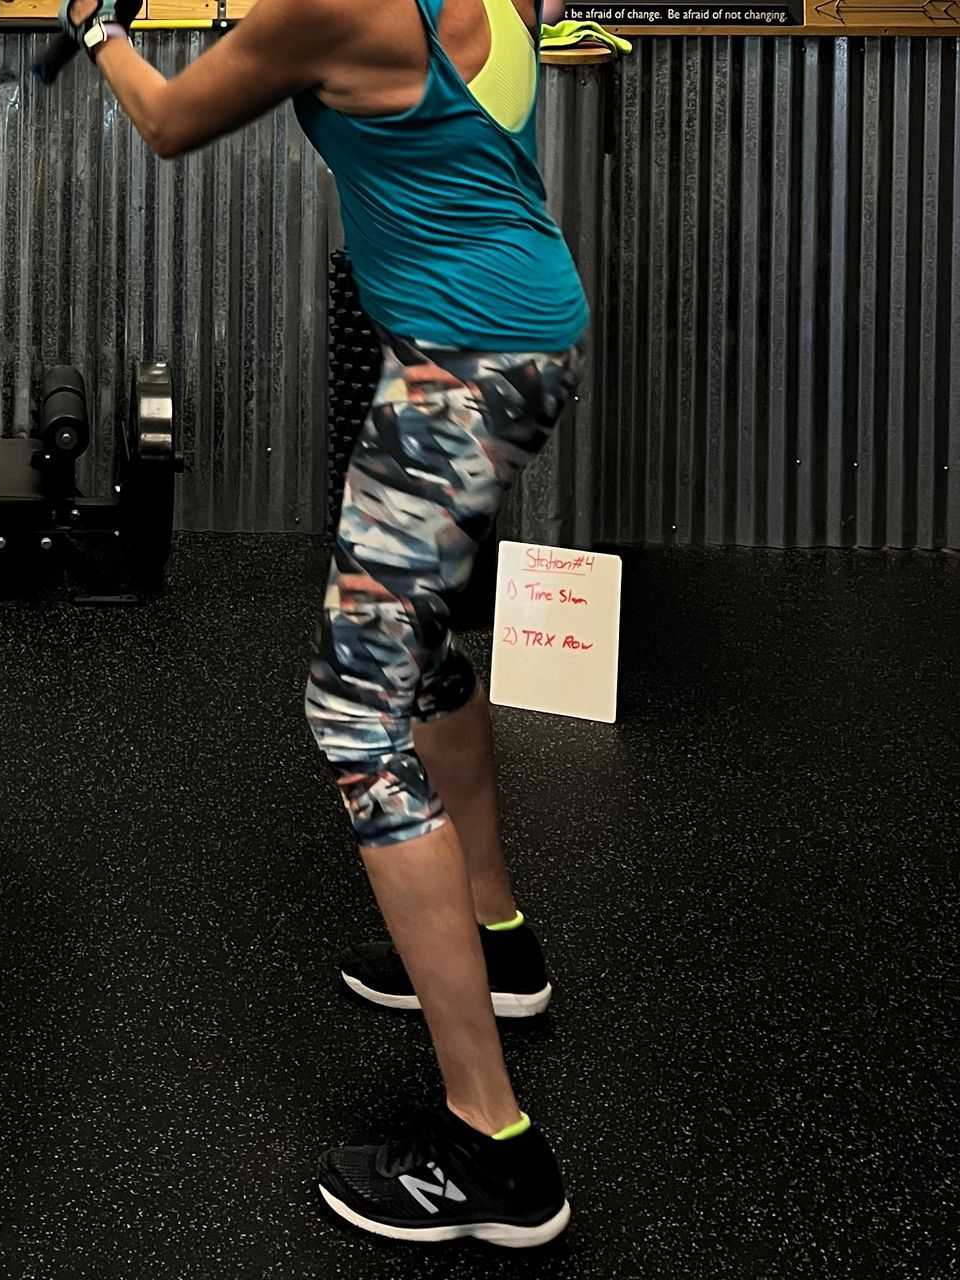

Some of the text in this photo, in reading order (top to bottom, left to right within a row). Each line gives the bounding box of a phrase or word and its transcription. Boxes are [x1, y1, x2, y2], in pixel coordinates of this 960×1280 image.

[571, 8, 583, 19] be
[585, 8, 612, 19] afraid
[614, 8, 626, 19] of
[627, 8, 663, 22] change.
[667, 8, 681, 19] Be
[682, 8, 710, 20] afraid
[712, 8, 723, 20] of
[724, 10, 742, 20] not
[744, 9, 788, 23] changing.
[525, 582, 553, 601] Tire
[502, 626, 518, 645] 2)
[522, 629, 556, 648] TRX
